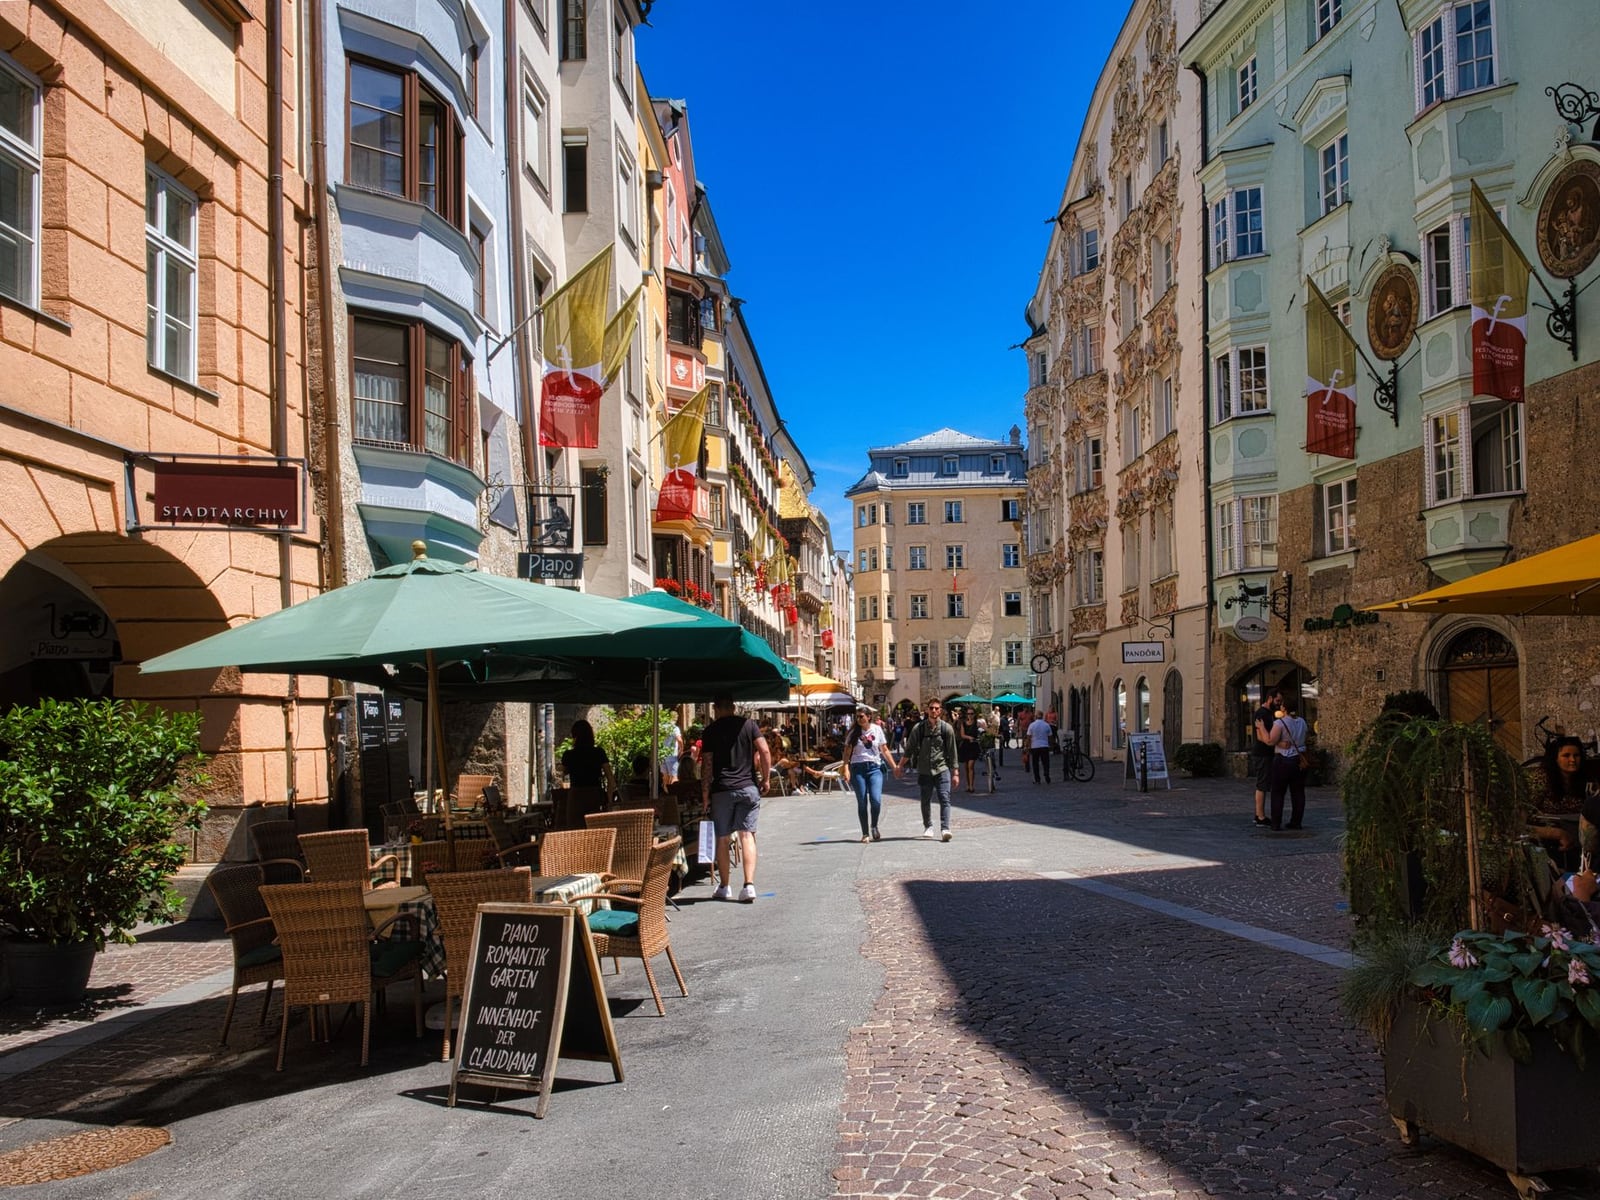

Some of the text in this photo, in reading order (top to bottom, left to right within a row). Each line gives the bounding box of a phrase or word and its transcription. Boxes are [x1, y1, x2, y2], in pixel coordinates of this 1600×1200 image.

[163, 505, 288, 519] STADTARCHIV
[528, 554, 574, 577] Piano
[38, 641, 69, 656] Piano
[501, 923, 539, 944] PIANO
[485, 945, 550, 967] ROMANTIK
[490, 967, 539, 989] GARTEN
[505, 991, 518, 1006] IM
[476, 1006, 542, 1029] INNENHOF
[495, 1030, 516, 1046] DER
[468, 1047, 538, 1074] CLAUDIANA
